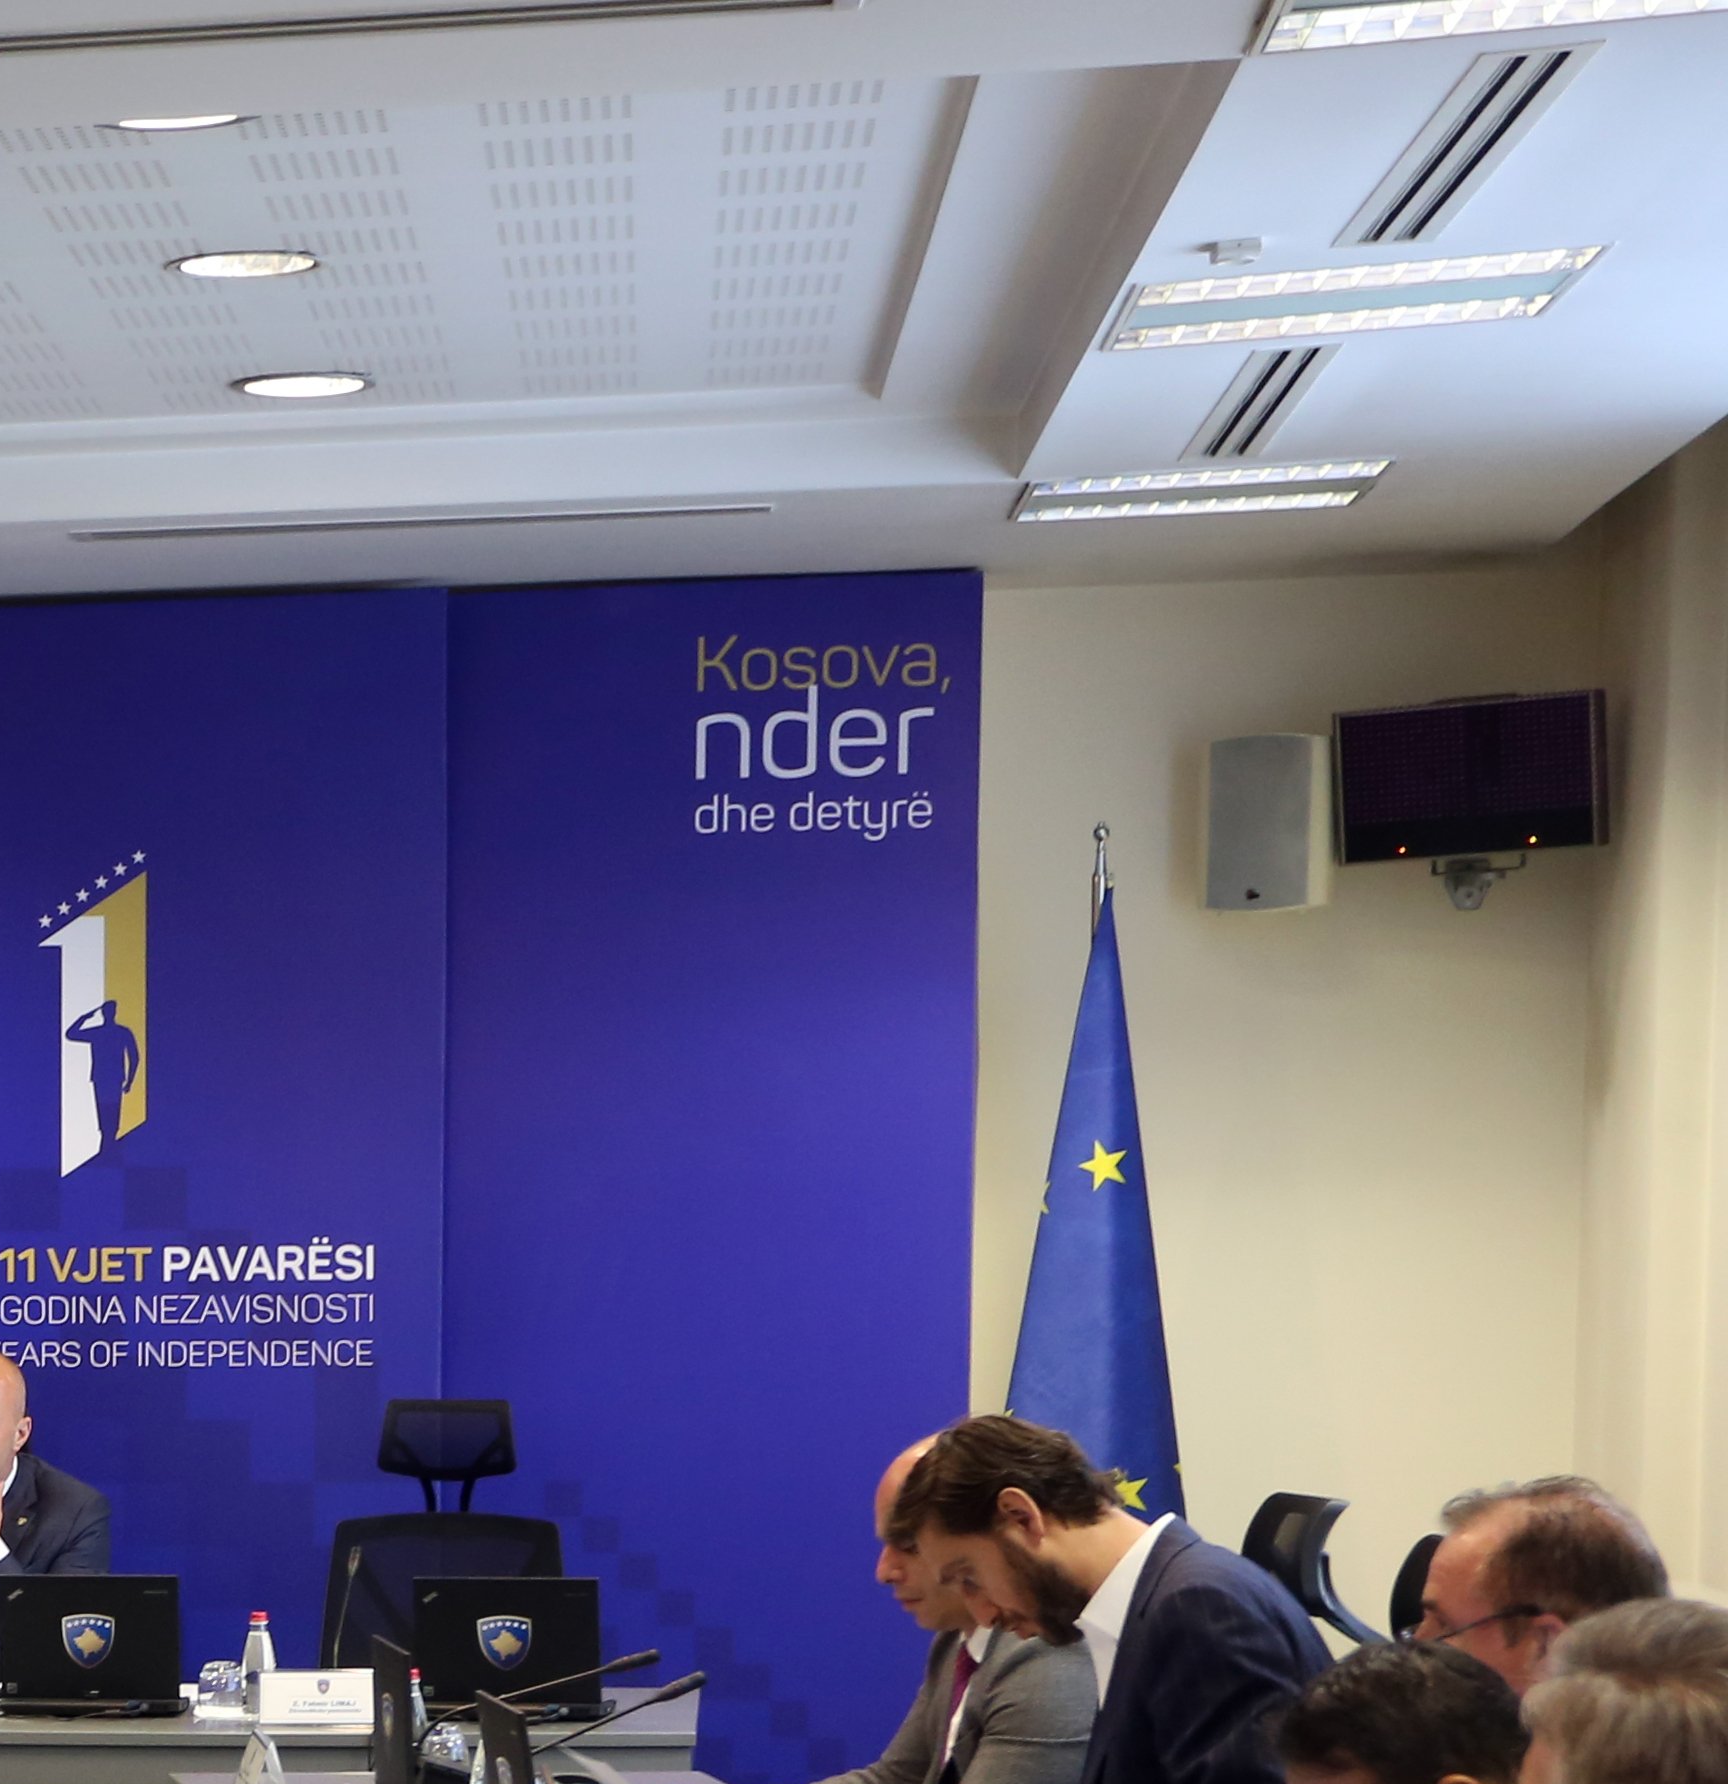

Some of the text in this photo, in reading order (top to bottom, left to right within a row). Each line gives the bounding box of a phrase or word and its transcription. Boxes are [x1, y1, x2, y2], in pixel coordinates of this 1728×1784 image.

[696, 634, 951, 694] Kosova,
[695, 684, 935, 780] nder
[694, 790, 933, 841] dhe detyrë
[47, 1246, 153, 1284] VJET
[162, 1236, 375, 1283] PAVARËSI
[0, 1294, 126, 1326] GODINA
[134, 1293, 375, 1325] NEZAVISNOSTI
[89, 1340, 130, 1368] OF
[137, 1339, 375, 1368] INDEPENDENCE
